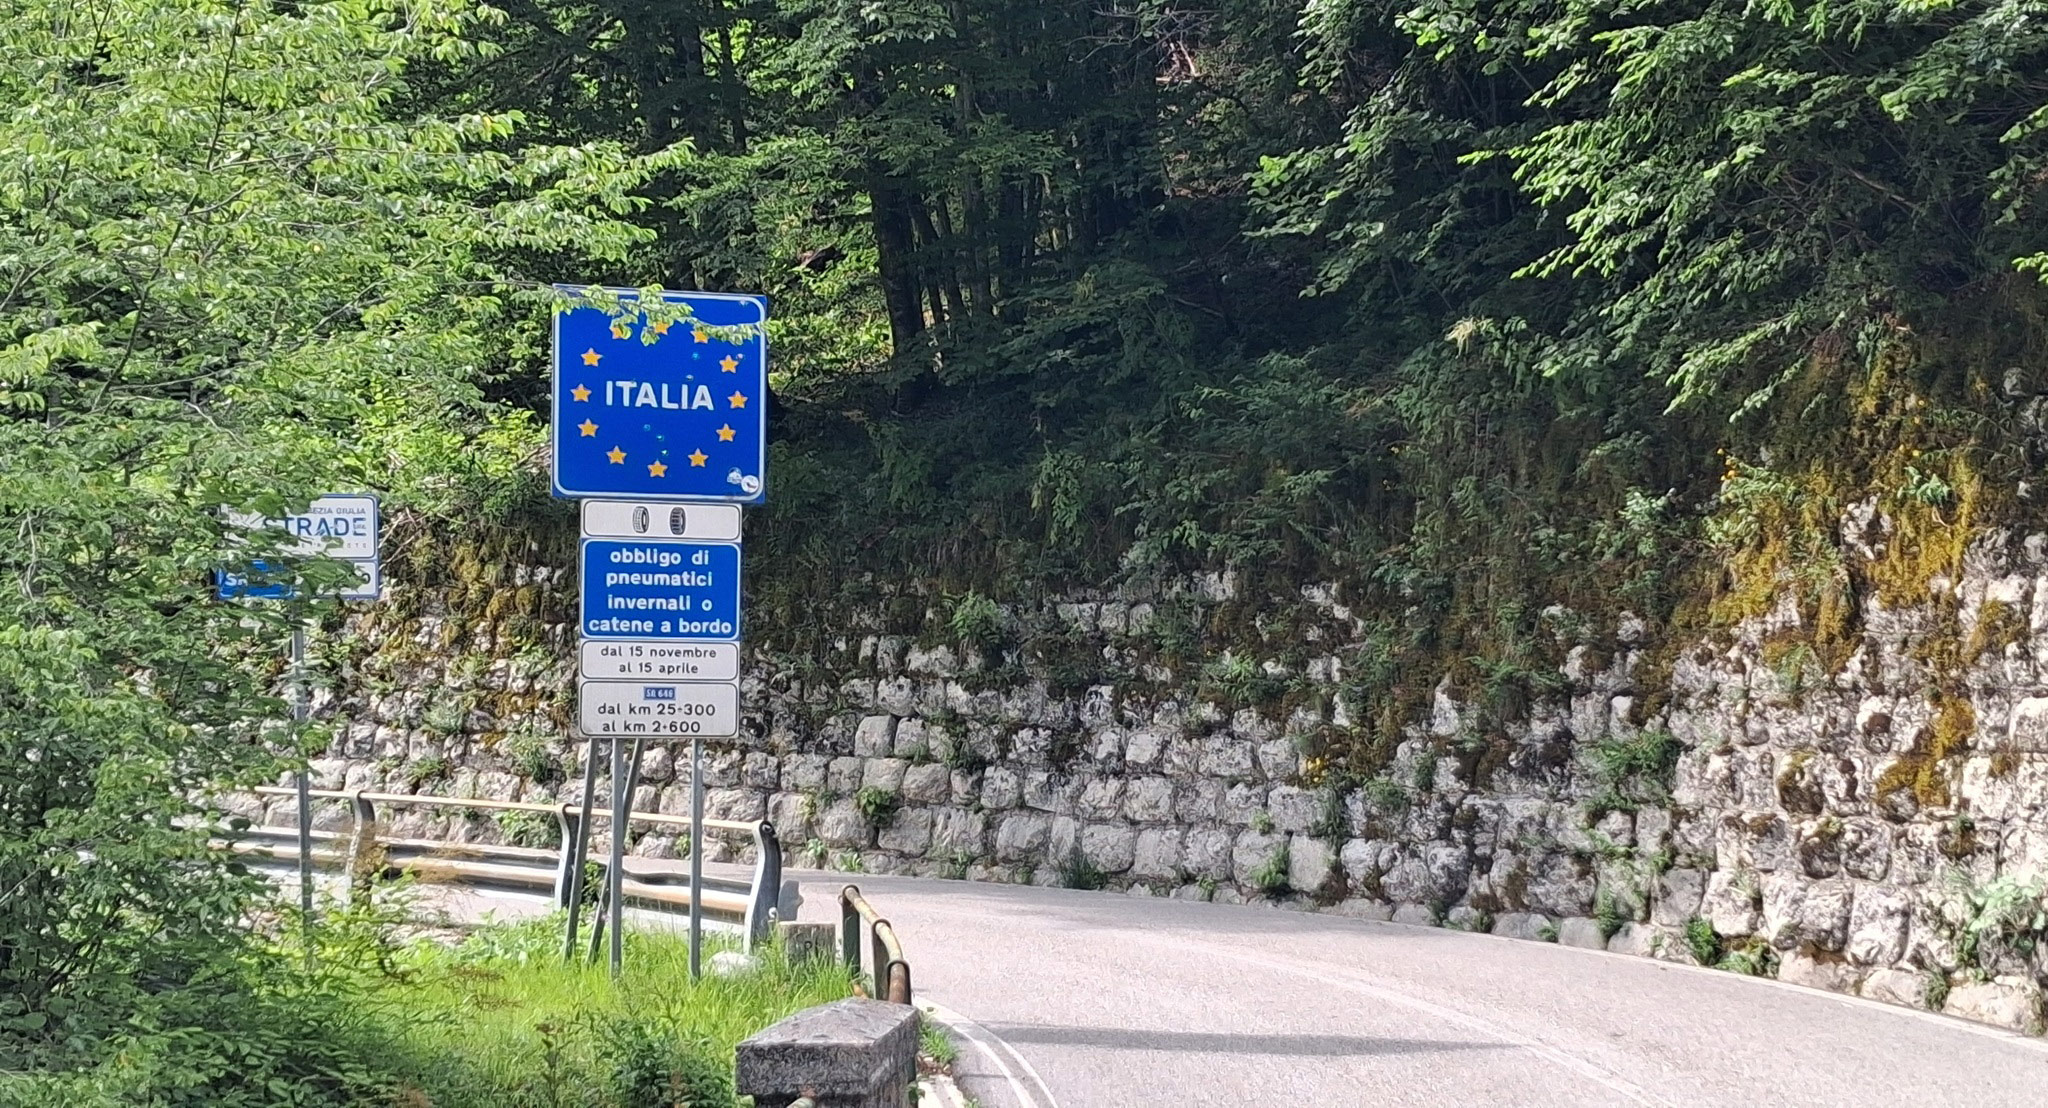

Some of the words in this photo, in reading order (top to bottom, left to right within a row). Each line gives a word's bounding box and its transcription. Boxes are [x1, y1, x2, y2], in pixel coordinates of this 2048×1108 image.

[606, 380, 714, 411] ITALIA
[610, 548, 682, 567] obbligo
[691, 549, 709, 565] di
[606, 571, 713, 587] pneumatici
[607, 594, 691, 611] invernali
[701, 599, 713, 612] o
[588, 616, 654, 633] catene
[660, 620, 672, 633] a
[679, 618, 732, 634] bordo
[600, 645, 623, 657] dal
[629, 646, 643, 657] 15
[650, 647, 717, 658] novembre
[619, 662, 632, 673] al
[638, 662, 652, 673] 15
[658, 662, 699, 675] aprile
[598, 703, 620, 715] dal
[629, 703, 651, 715] km
[602, 720, 616, 732] al
[623, 720, 646, 732] km
